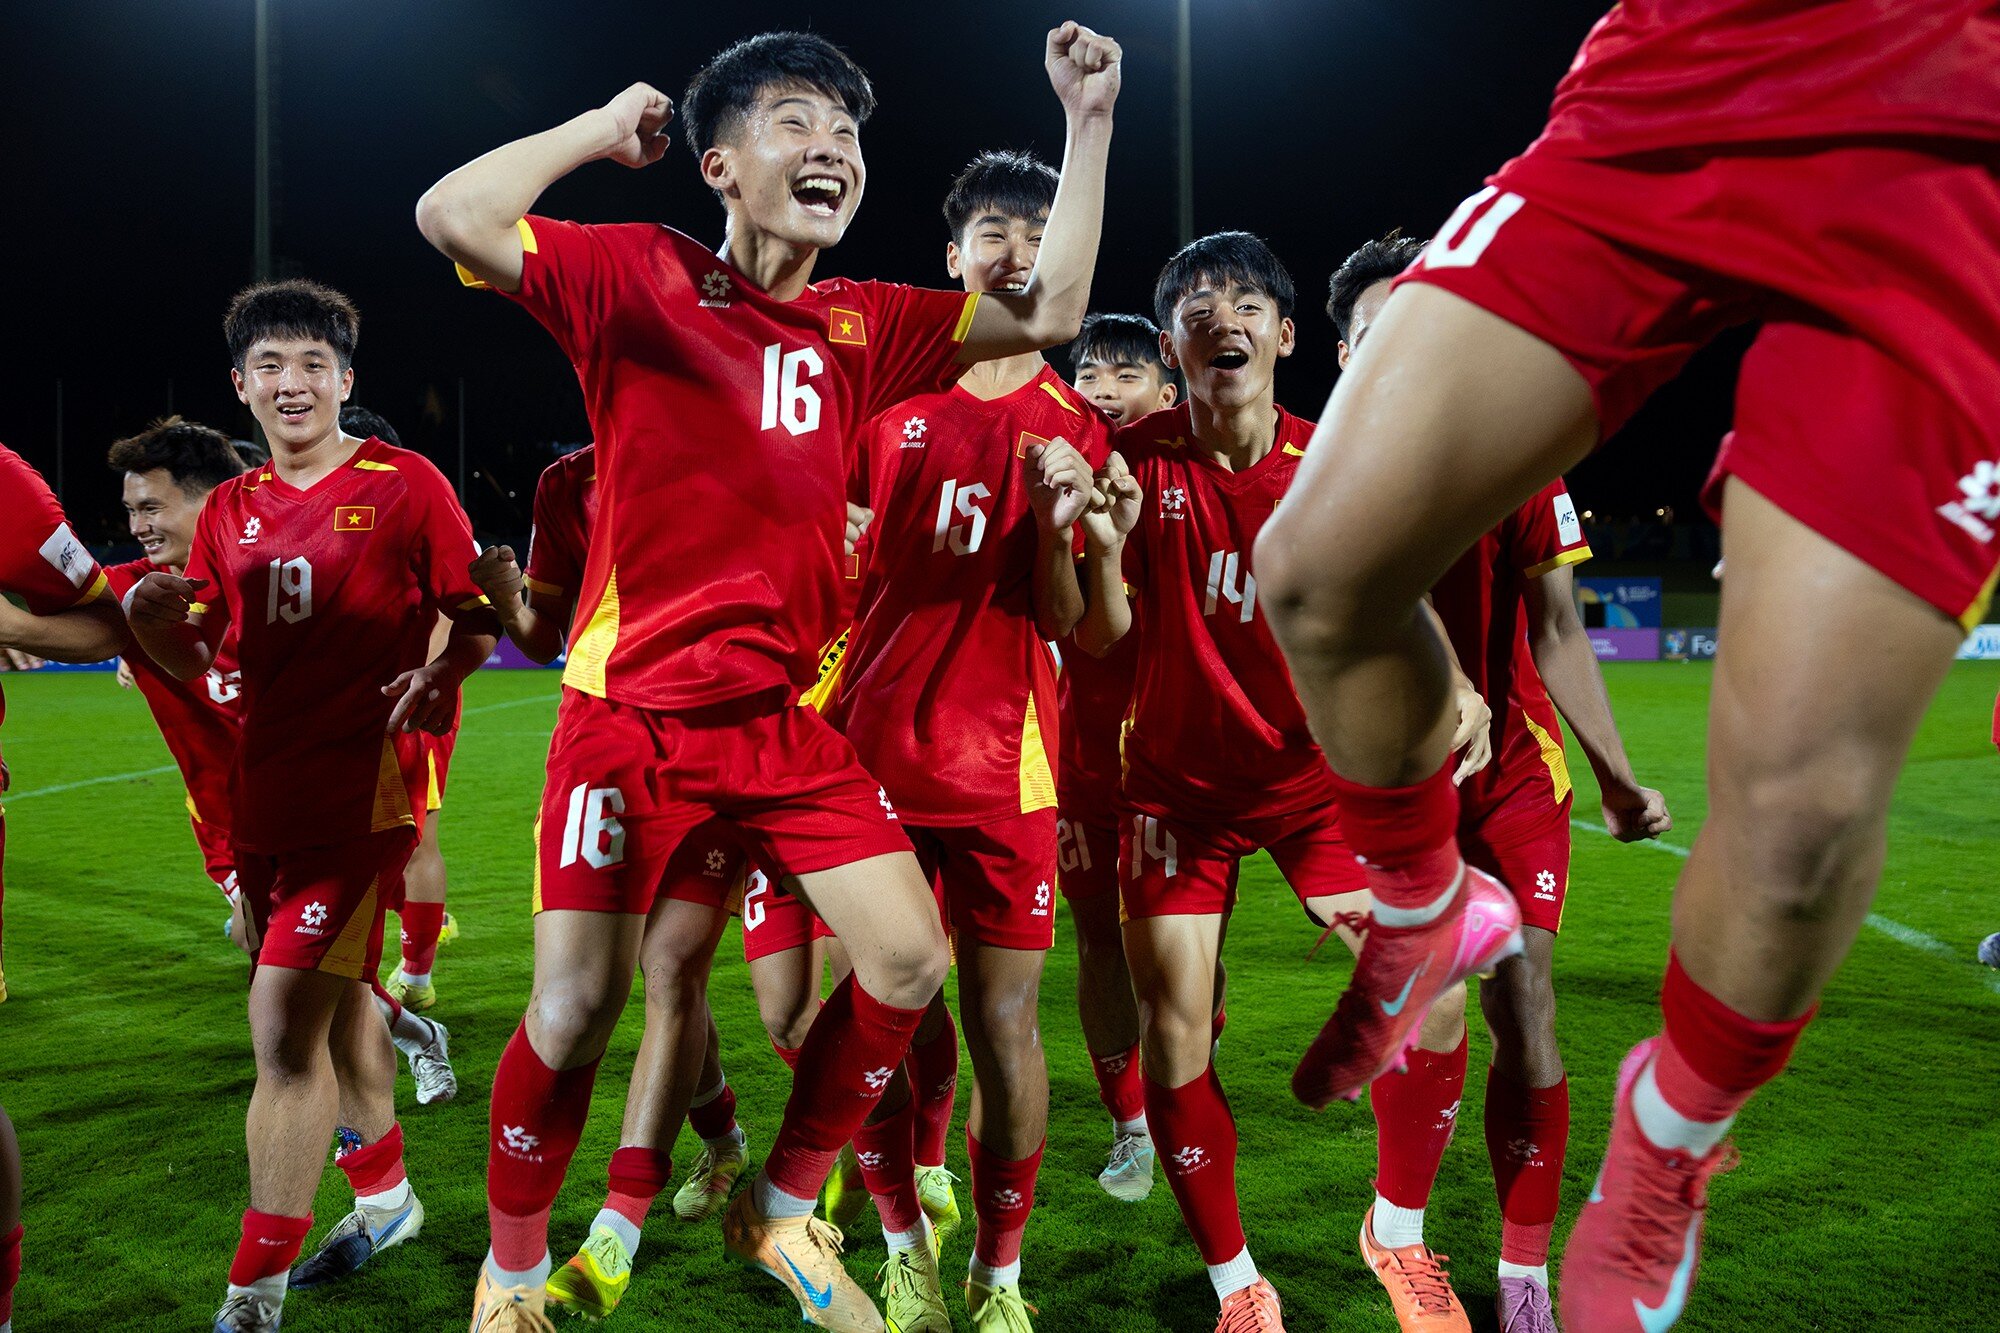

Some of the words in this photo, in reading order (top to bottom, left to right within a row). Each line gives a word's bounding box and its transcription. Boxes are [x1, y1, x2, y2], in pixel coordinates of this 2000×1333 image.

[760, 342, 824, 437] 16
[932, 478, 992, 557] 15
[60, 540, 77, 571] AFC
[266, 555, 312, 625] 19
[1203, 549, 1258, 624] 14
[560, 781, 626, 870] 16
[1056, 818, 1092, 872] 21
[1131, 814, 1178, 880] 14
